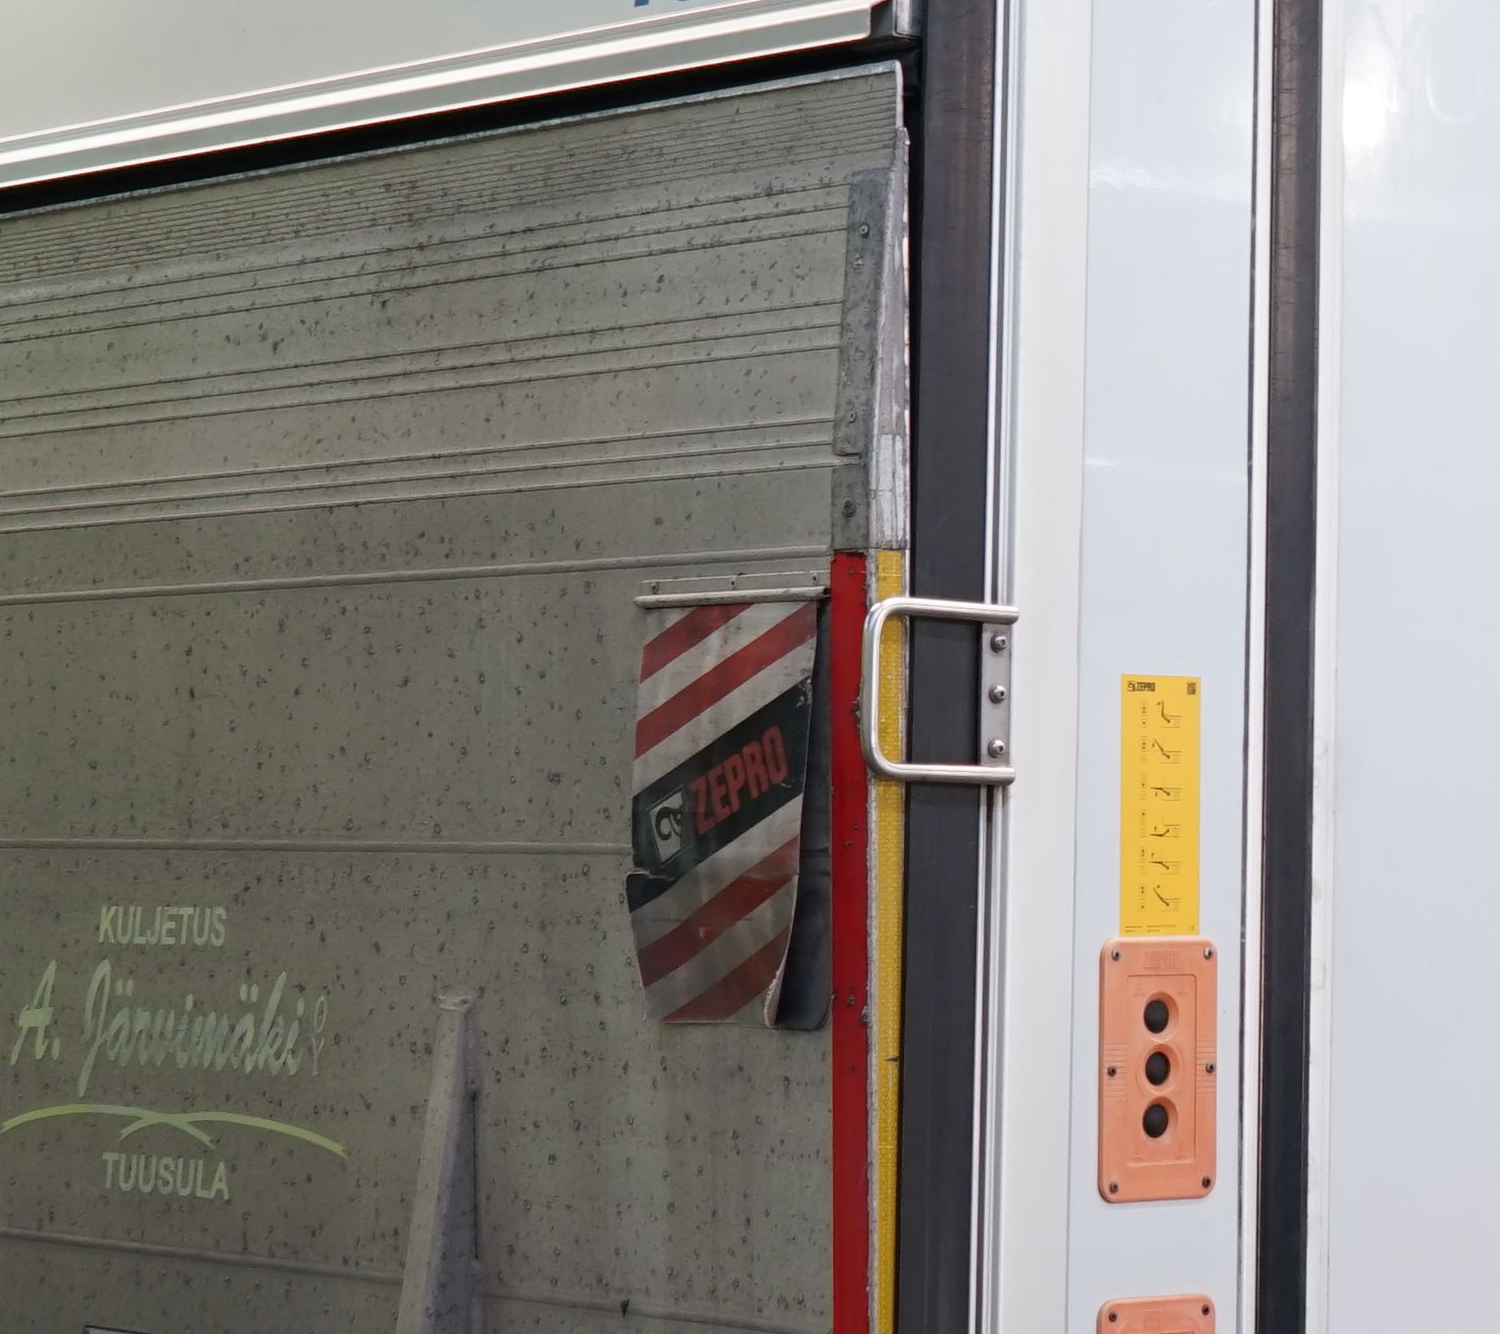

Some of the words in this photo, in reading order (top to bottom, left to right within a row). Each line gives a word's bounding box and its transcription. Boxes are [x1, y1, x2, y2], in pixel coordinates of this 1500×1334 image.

[689, 724, 789, 835] ZEPRO
[98, 905, 228, 947] KULJETUS
[9, 958, 61, 1067] A.
[101, 1151, 230, 1200] TUUSULA
